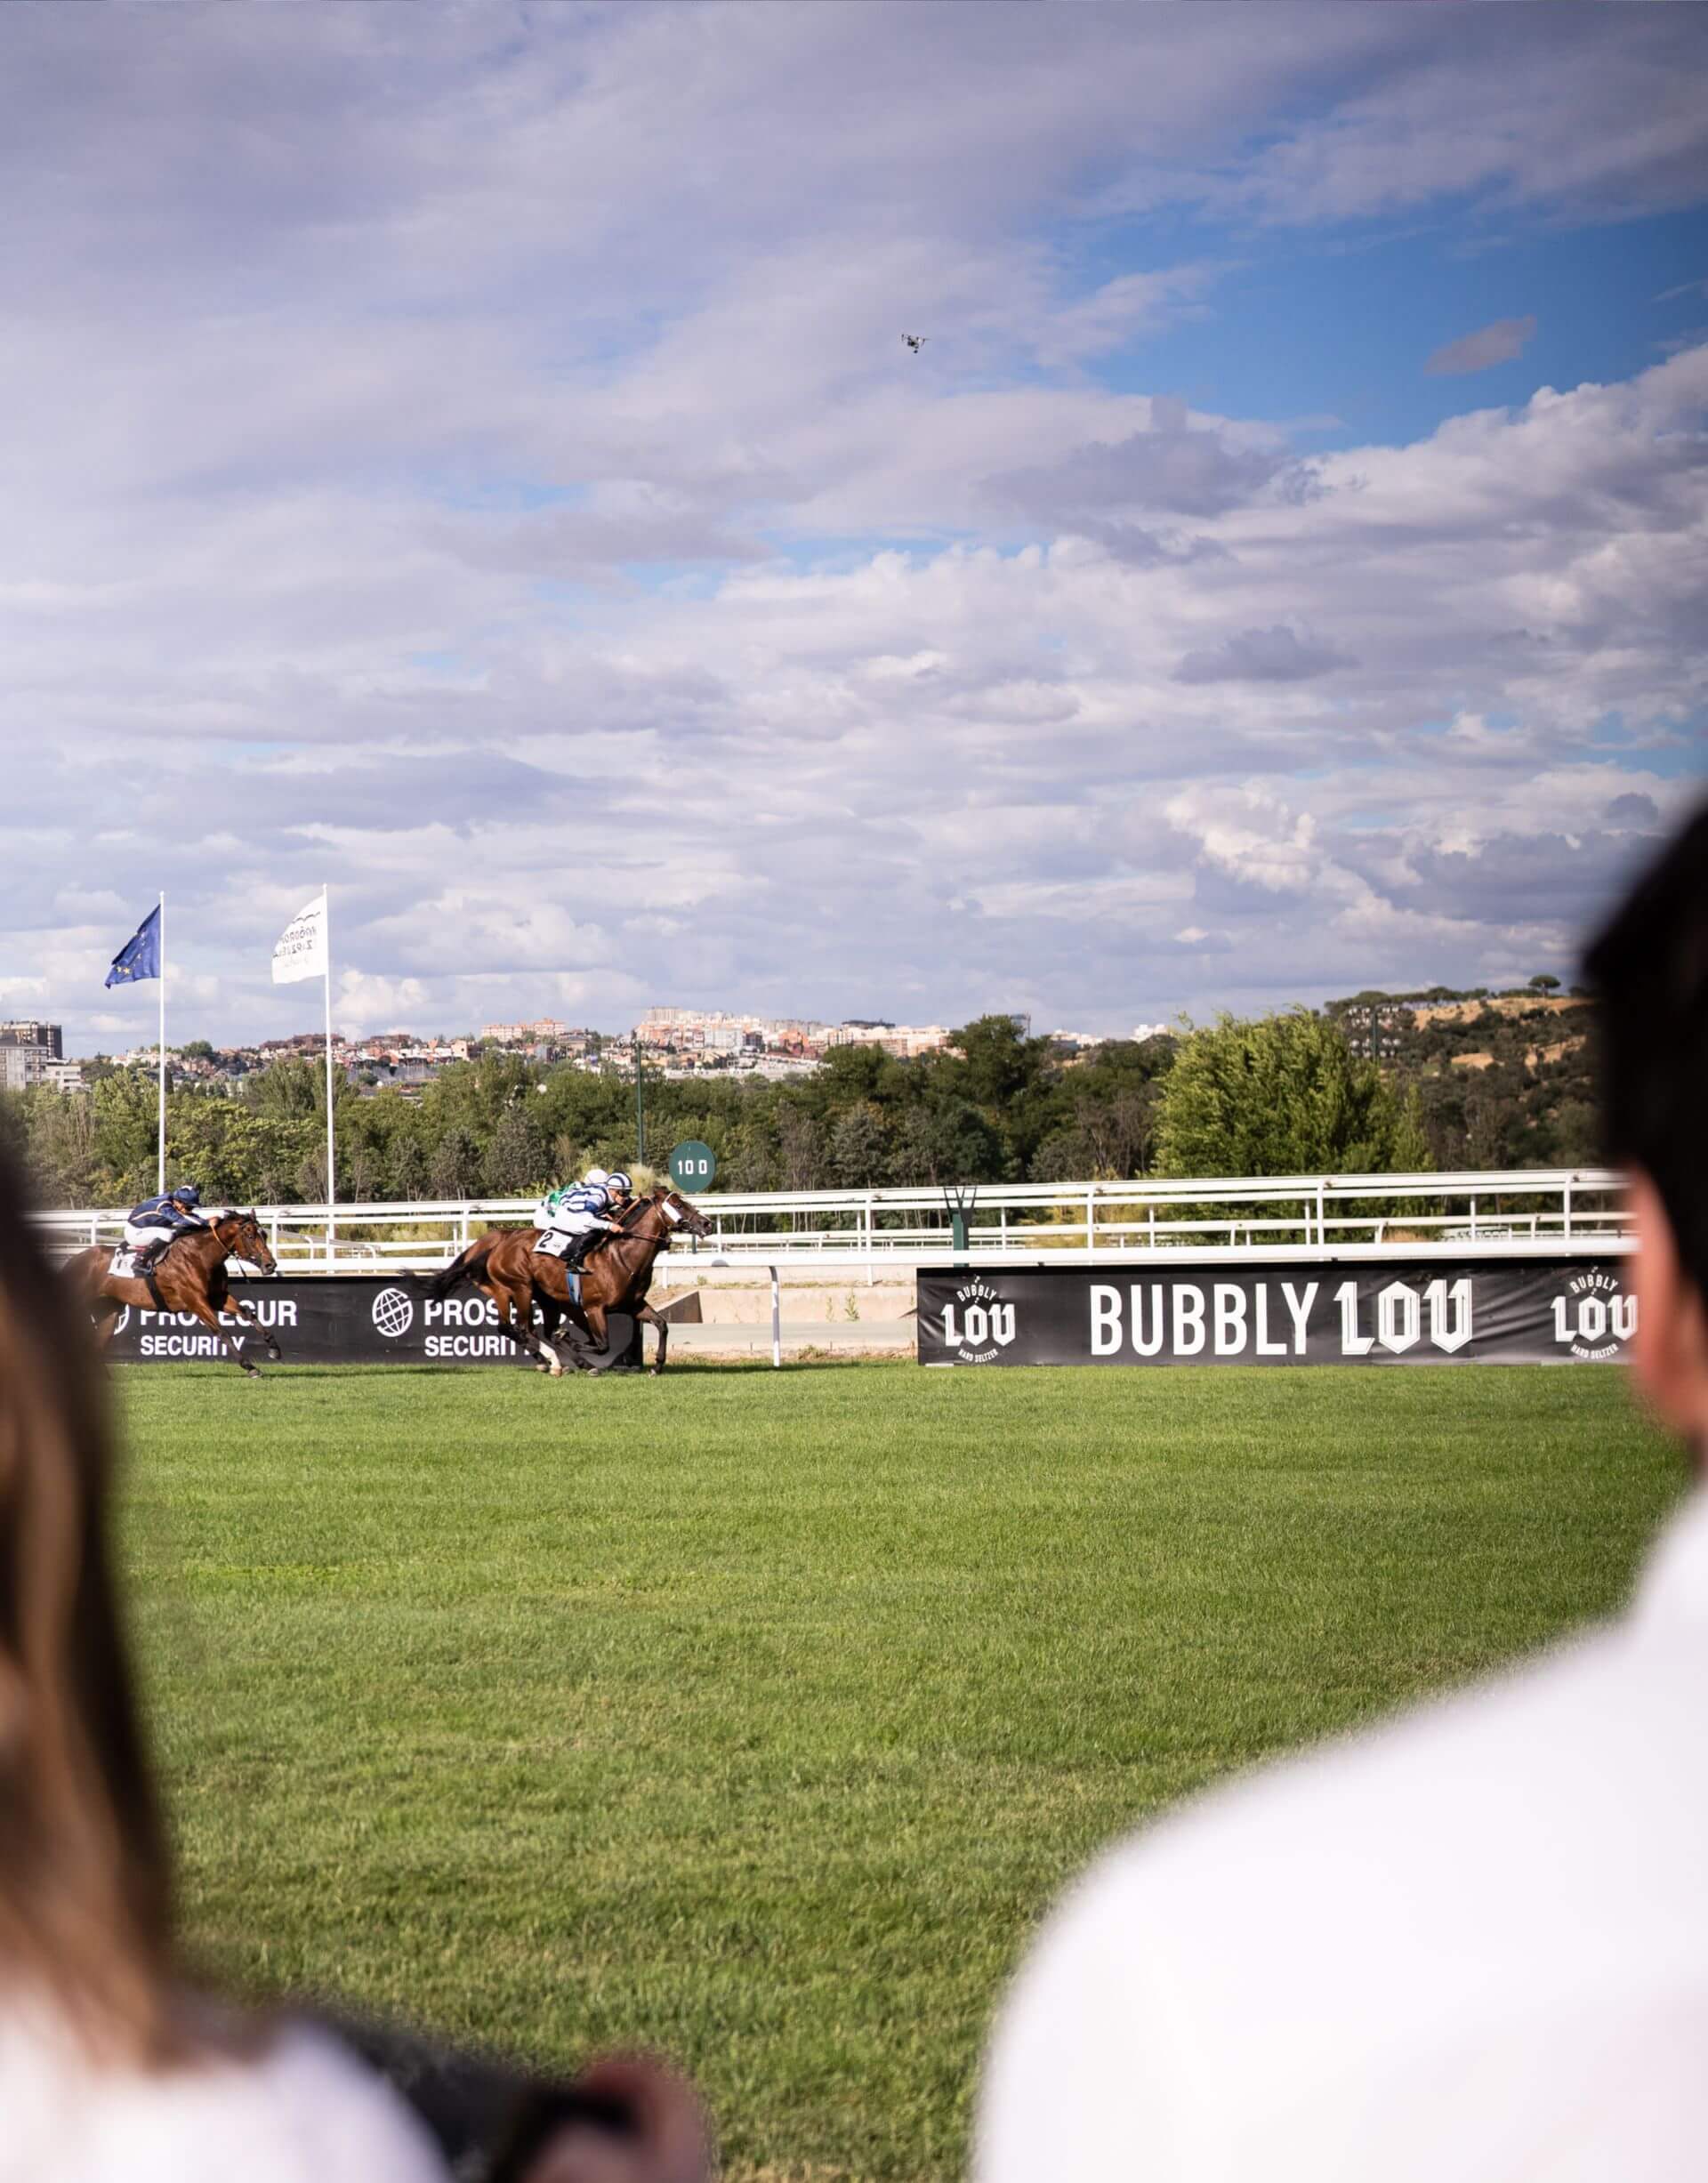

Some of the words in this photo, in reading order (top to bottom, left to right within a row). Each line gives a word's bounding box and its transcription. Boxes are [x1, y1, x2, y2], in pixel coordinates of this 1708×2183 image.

[678, 1159, 707, 1174] 100
[539, 1232, 553, 1248] 2
[956, 1285, 997, 1301] BUBBLY
[1570, 1274, 1618, 1293] BUBBLY
[940, 1303, 1016, 1346] LOU
[1090, 1282, 1319, 1356] BUBBLY
[1334, 1278, 1472, 1354] LOU
[1551, 1294, 1638, 1342] LOU
[424, 1335, 530, 1356] SECURIT
